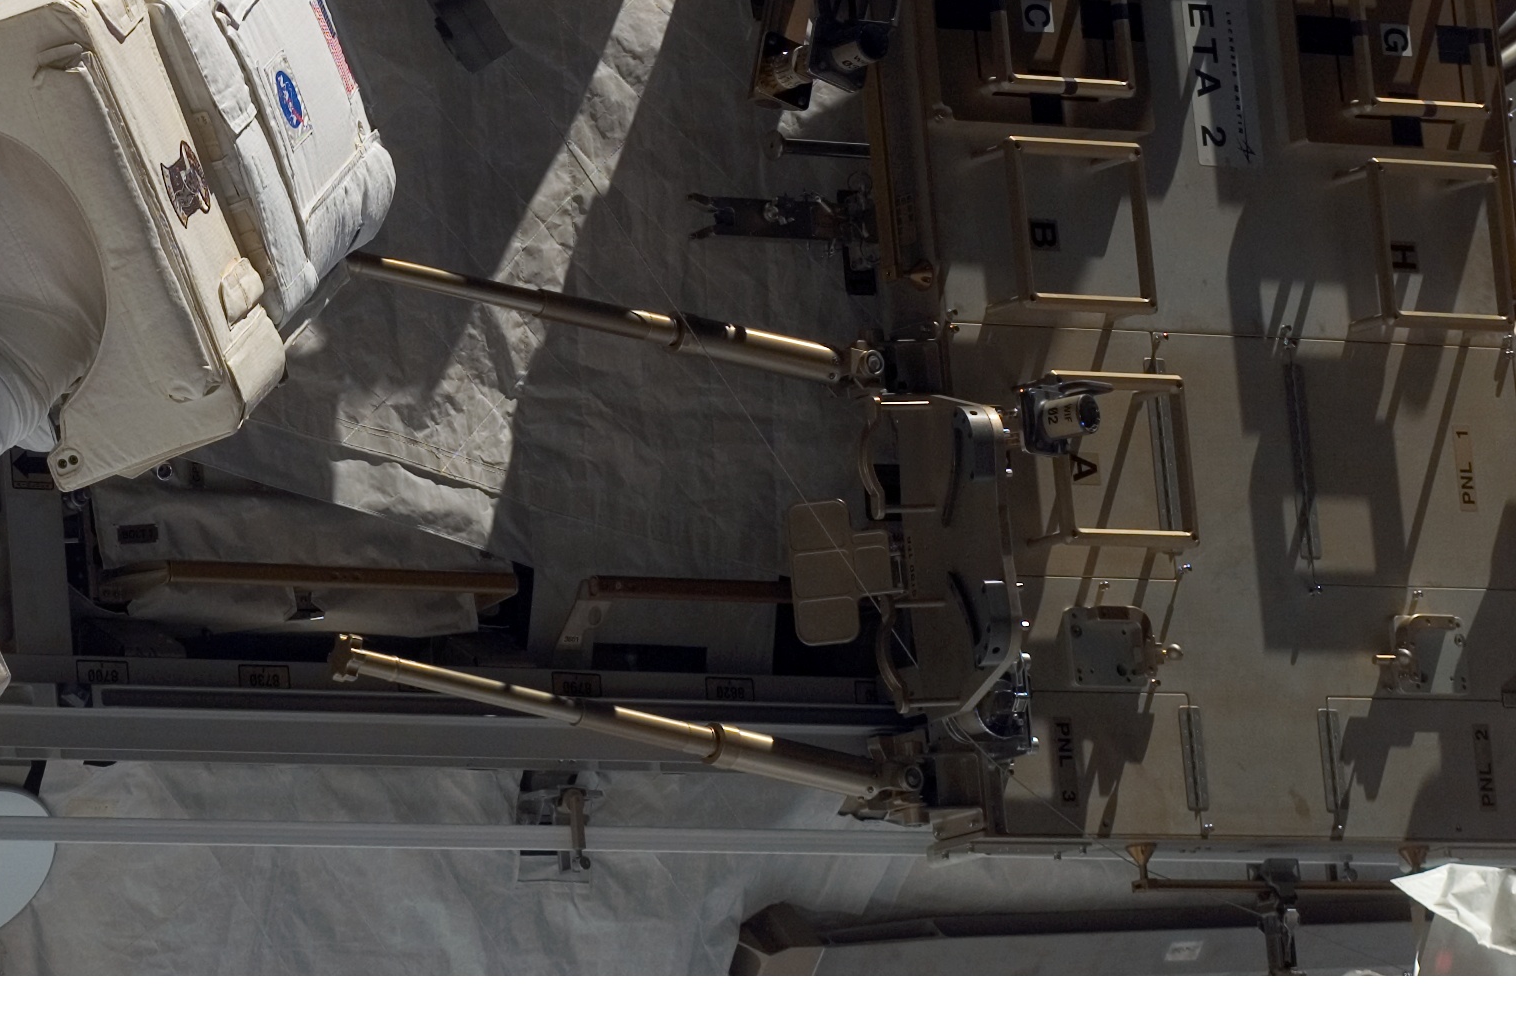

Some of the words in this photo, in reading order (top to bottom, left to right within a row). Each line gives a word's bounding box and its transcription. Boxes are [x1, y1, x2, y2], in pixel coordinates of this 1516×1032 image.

[1024, 4, 1051, 28] C
[1383, 28, 1409, 52] G
[1226, 11, 1237, 77] LOCKHEED
[1233, 84, 1243, 135] MARTIN
[1201, 125, 1227, 147] 2
[1030, 223, 1057, 248] B
[1390, 244, 1417, 270] H
[1048, 407, 1059, 426] 02
[1063, 403, 1073, 423] WIF
[1456, 431, 1469, 439] 1
[1070, 454, 1098, 482] A
[1459, 462, 1476, 505] PNL
[87, 669, 119, 683] 8700
[249, 673, 280, 688] 8730
[1054, 722, 1073, 768] PNL
[1474, 729, 1489, 741] 2
[1062, 790, 1076, 802] 3
[1479, 763, 1495, 807] PNL
